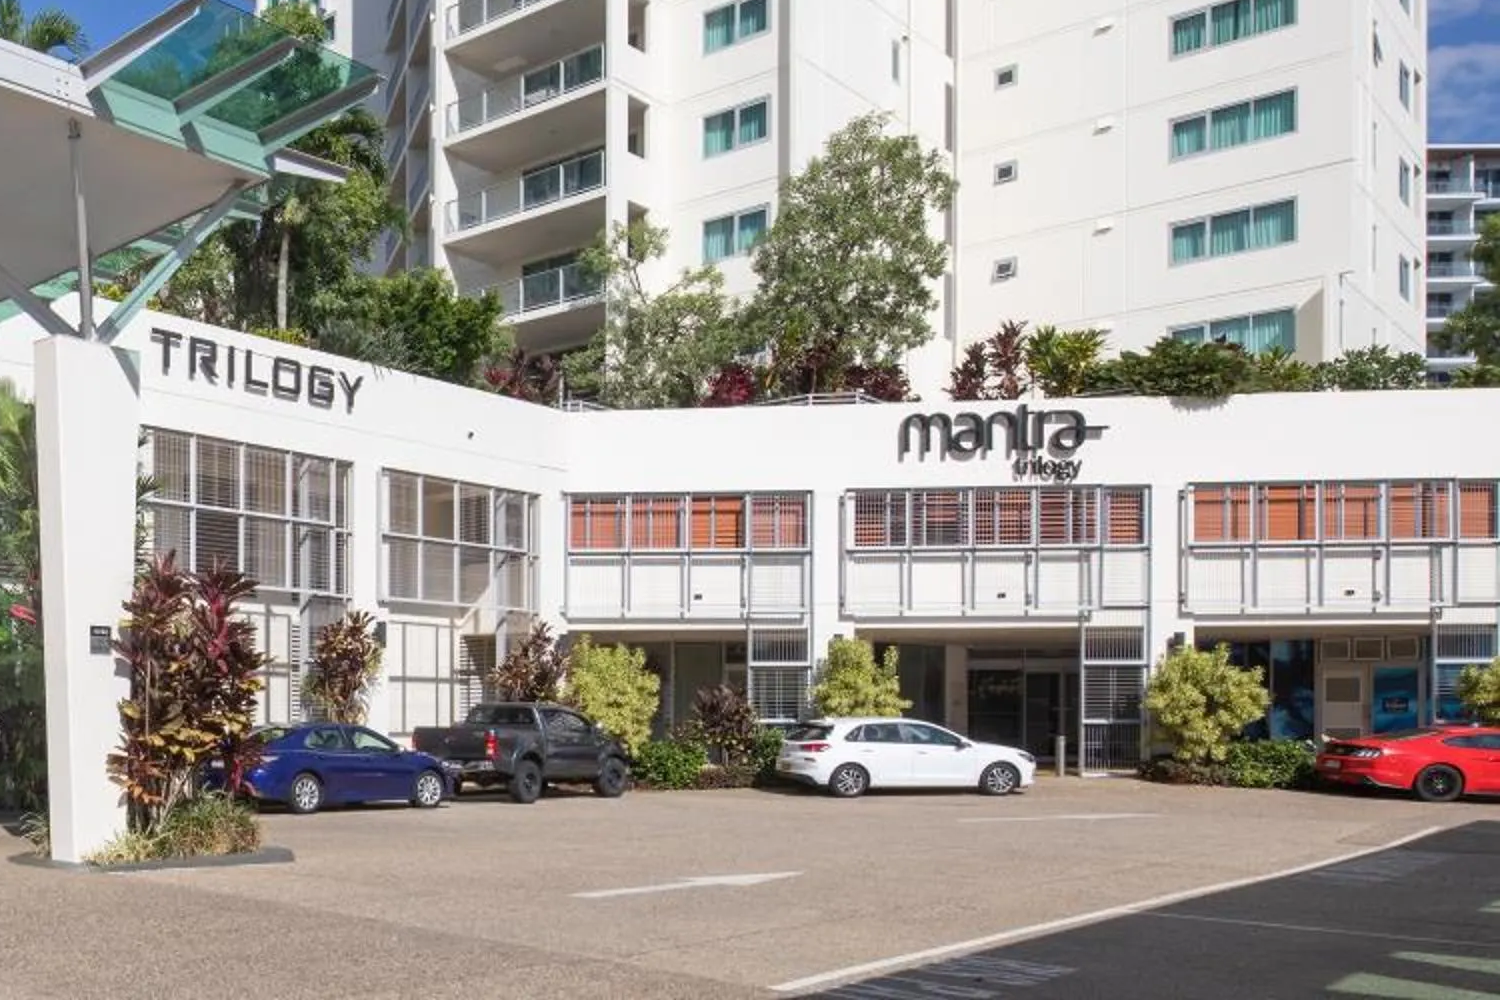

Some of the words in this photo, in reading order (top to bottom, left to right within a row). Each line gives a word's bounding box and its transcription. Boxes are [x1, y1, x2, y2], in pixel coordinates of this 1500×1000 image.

[151, 327, 363, 411] TRILOGY
[899, 404, 1109, 457] mantra
[1013, 456, 1082, 481] trilogy
